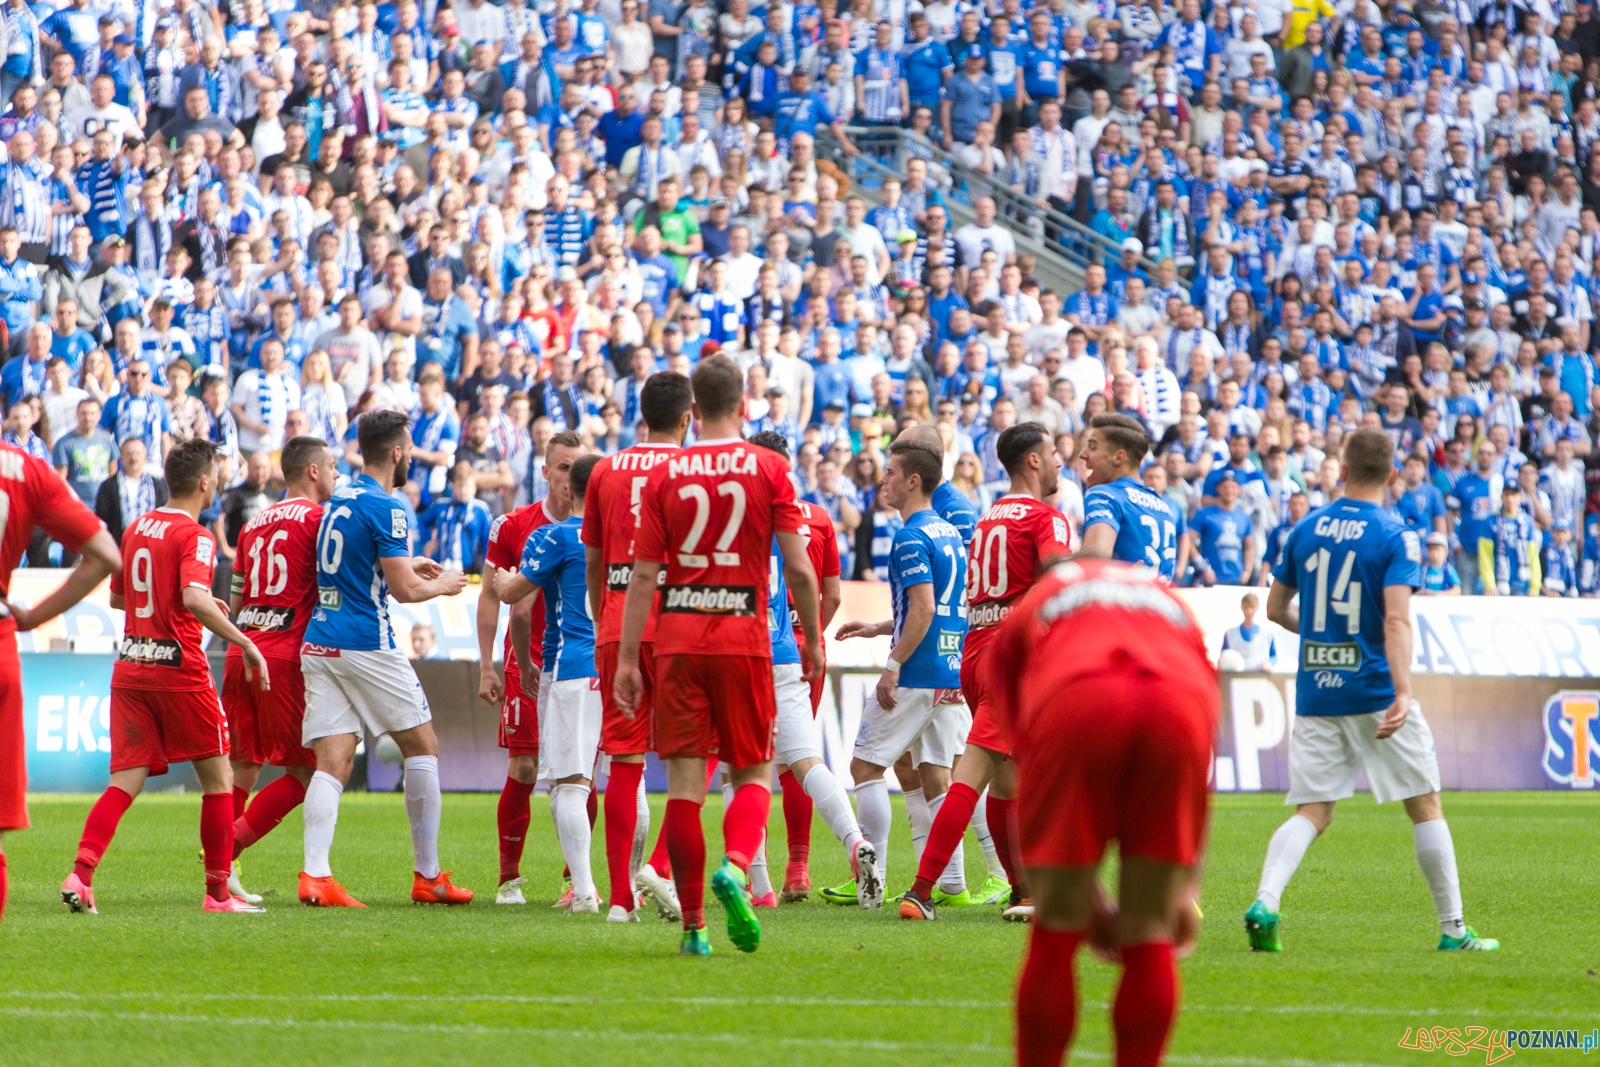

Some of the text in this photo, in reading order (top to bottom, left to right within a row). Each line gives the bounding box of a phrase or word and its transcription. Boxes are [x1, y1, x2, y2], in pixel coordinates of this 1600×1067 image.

[668, 448, 758, 480] MALOČA
[134, 517, 172, 540] MAK
[677, 480, 746, 568] 22
[1314, 516, 1368, 544] GAJOS
[131, 547, 155, 619] 9
[249, 529, 289, 598] 16
[1304, 546, 1362, 635] 14
[1308, 646, 1356, 665] LECH
[1314, 670, 1346, 690] Pils
[1542, 690, 1600, 787] ST
